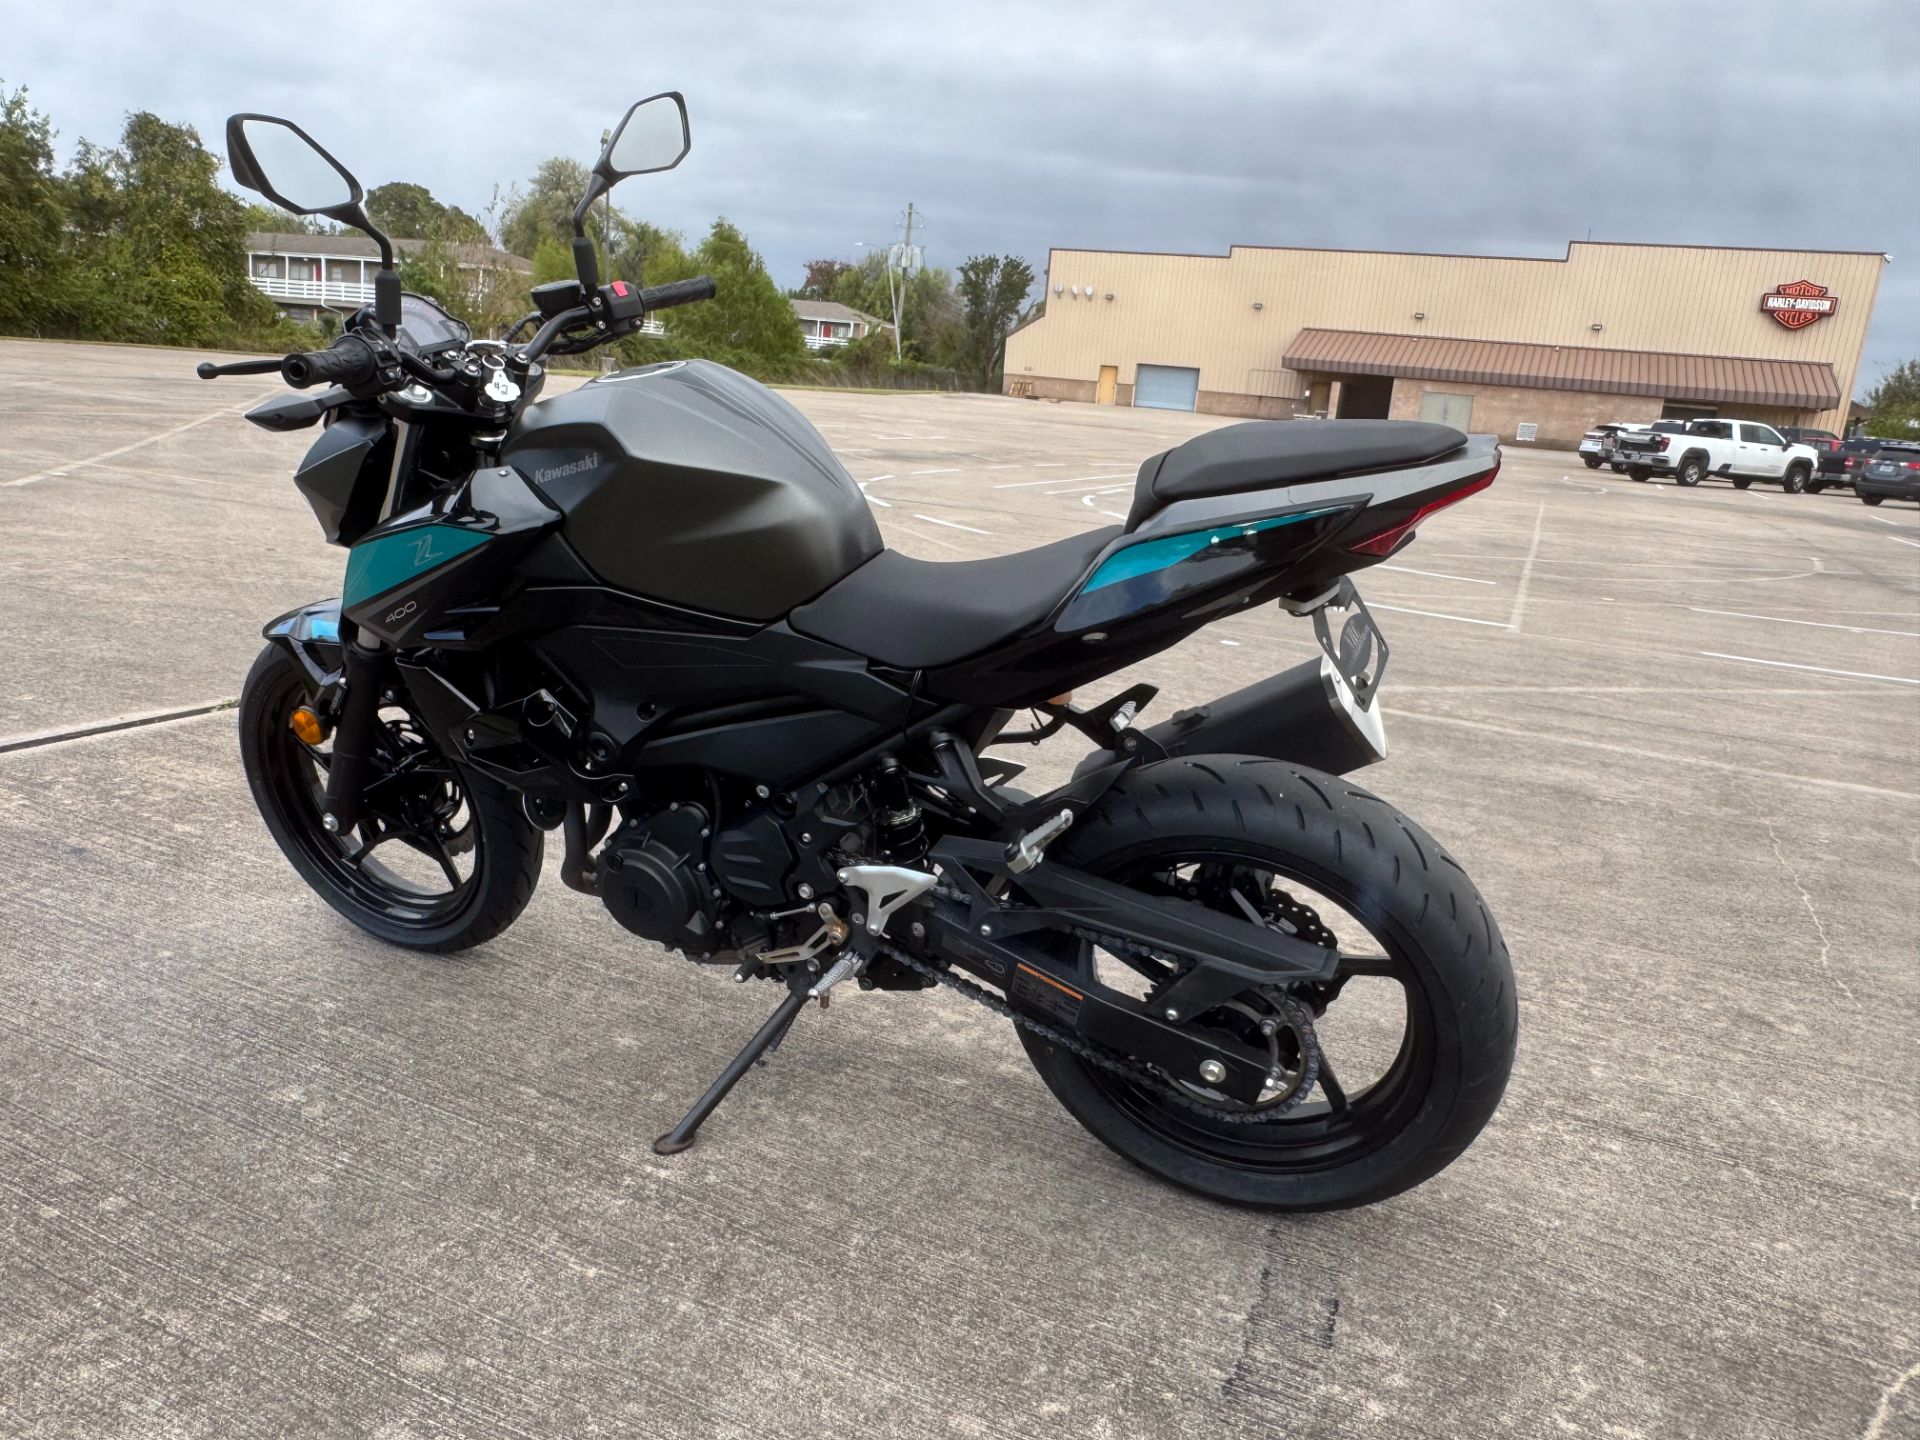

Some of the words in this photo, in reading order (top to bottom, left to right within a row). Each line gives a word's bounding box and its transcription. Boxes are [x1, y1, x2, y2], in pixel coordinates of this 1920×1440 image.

[1785, 284, 1819, 296] MOTOR
[1767, 296, 1831, 311] HARLEY-DAVIDSON
[1779, 311, 1813, 325] CYCLES
[535, 452, 598, 484] Kawasaki
[385, 601, 416, 623] 400
